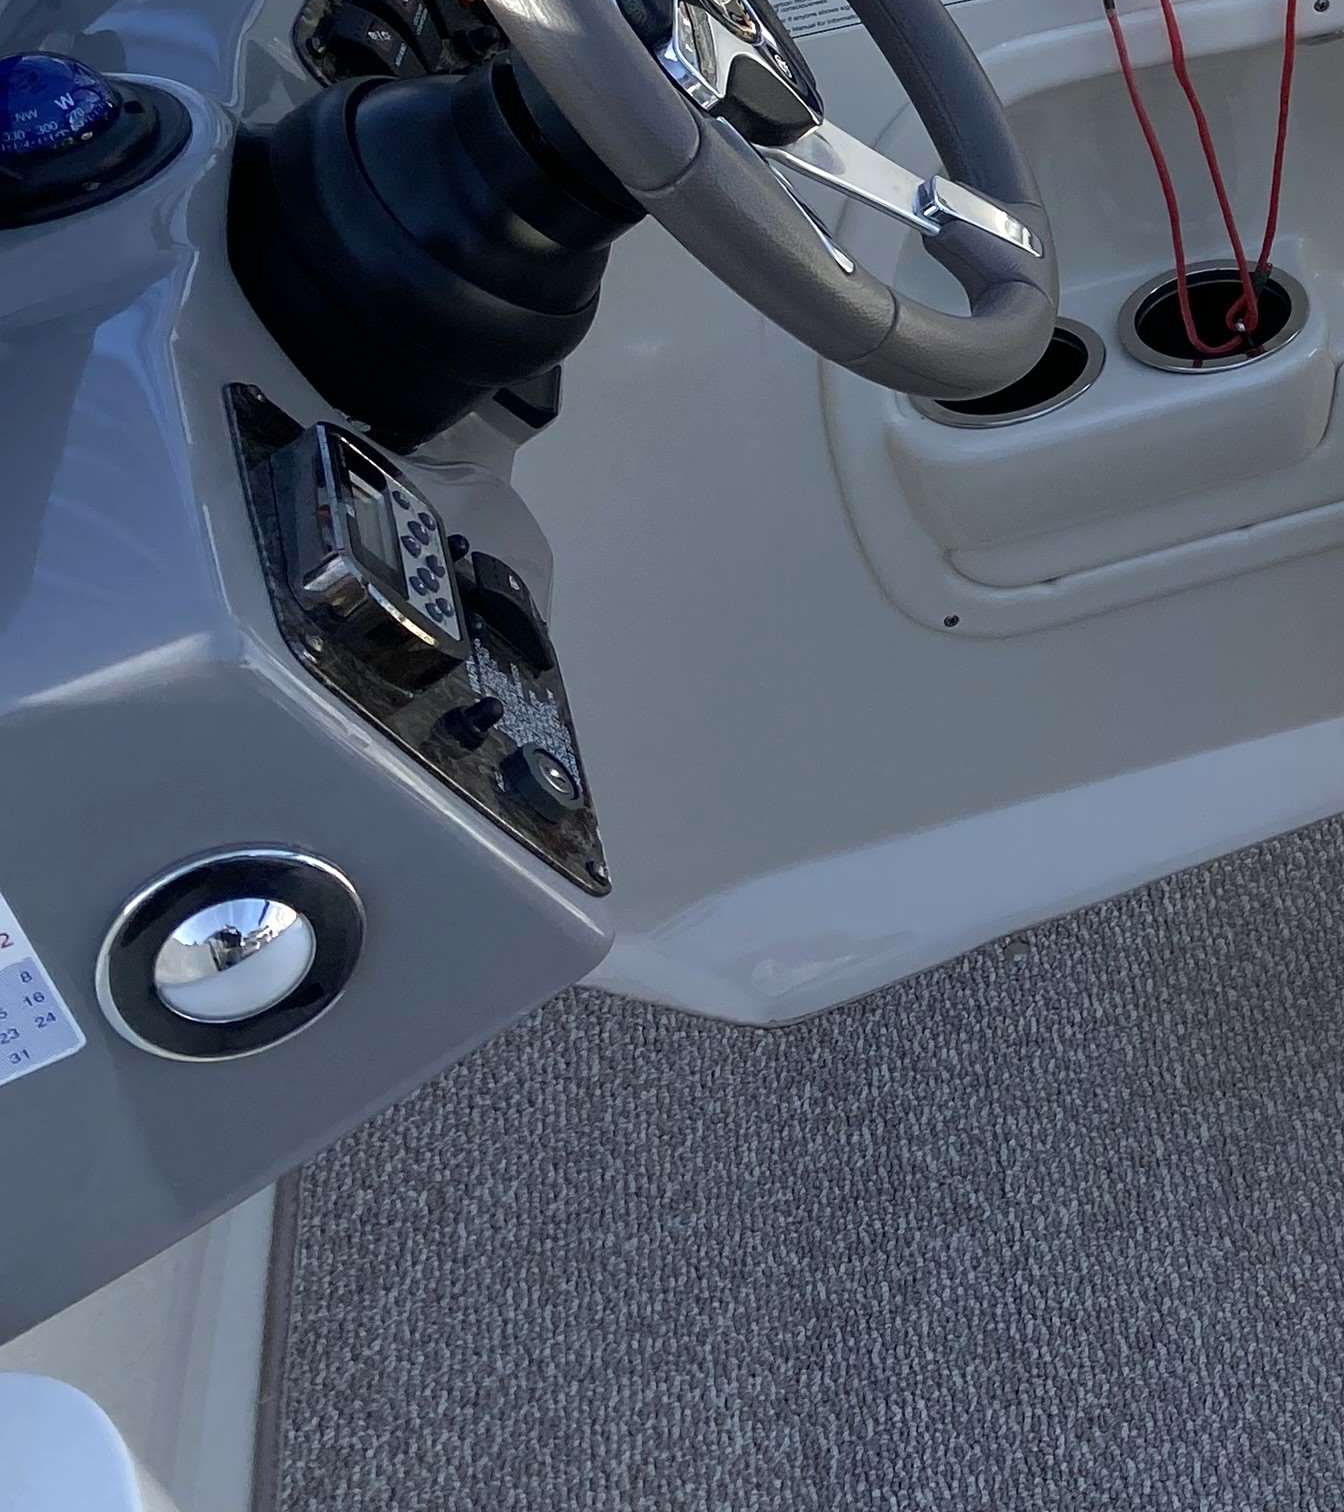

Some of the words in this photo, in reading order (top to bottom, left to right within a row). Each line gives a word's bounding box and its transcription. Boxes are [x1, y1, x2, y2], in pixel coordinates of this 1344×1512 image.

[54, 92, 75, 110] W
[20, 971, 33, 983] 8
[23, 991, 45, 1007] 16
[34, 1012, 57, 1028] 24
[9, 1049, 30, 1064] 31
